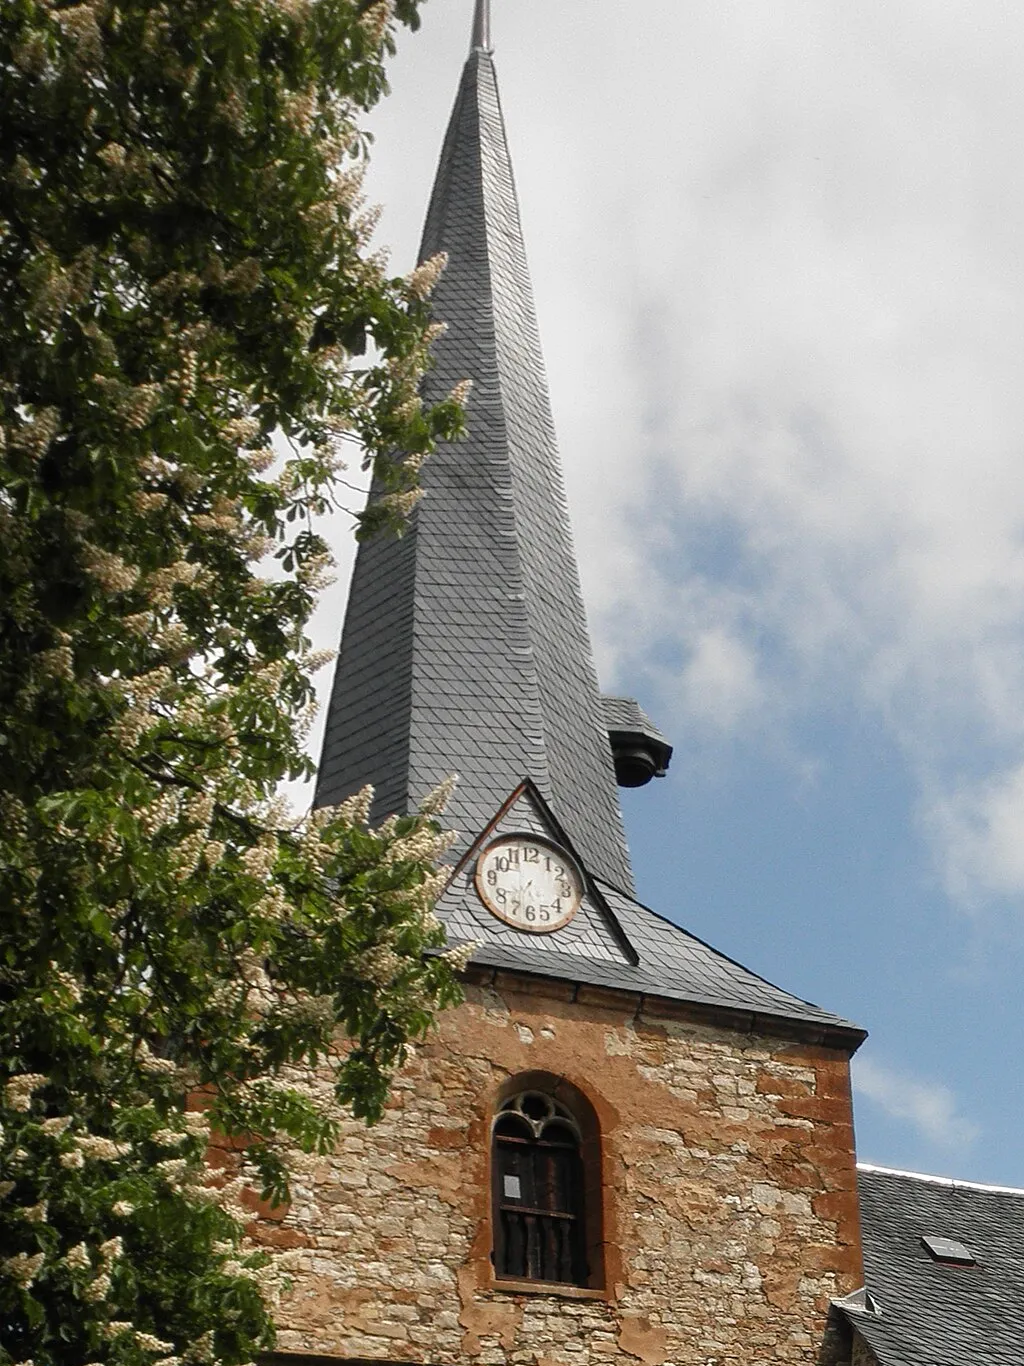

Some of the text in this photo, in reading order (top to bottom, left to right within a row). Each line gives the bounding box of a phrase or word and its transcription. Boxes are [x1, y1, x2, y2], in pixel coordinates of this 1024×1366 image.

[508, 848, 520, 864] 11
[523, 847, 539, 863] 12
[494, 856, 509, 872] 10
[544, 857, 551, 872] 1
[487, 870, 497, 885] 9
[555, 867, 564, 881] 2
[496, 888, 507, 904] 8
[561, 884, 571, 897] 3
[512, 900, 520, 915] 7
[526, 906, 535, 921] 6
[540, 905, 550, 921] 5
[551, 899, 562, 913] 4
